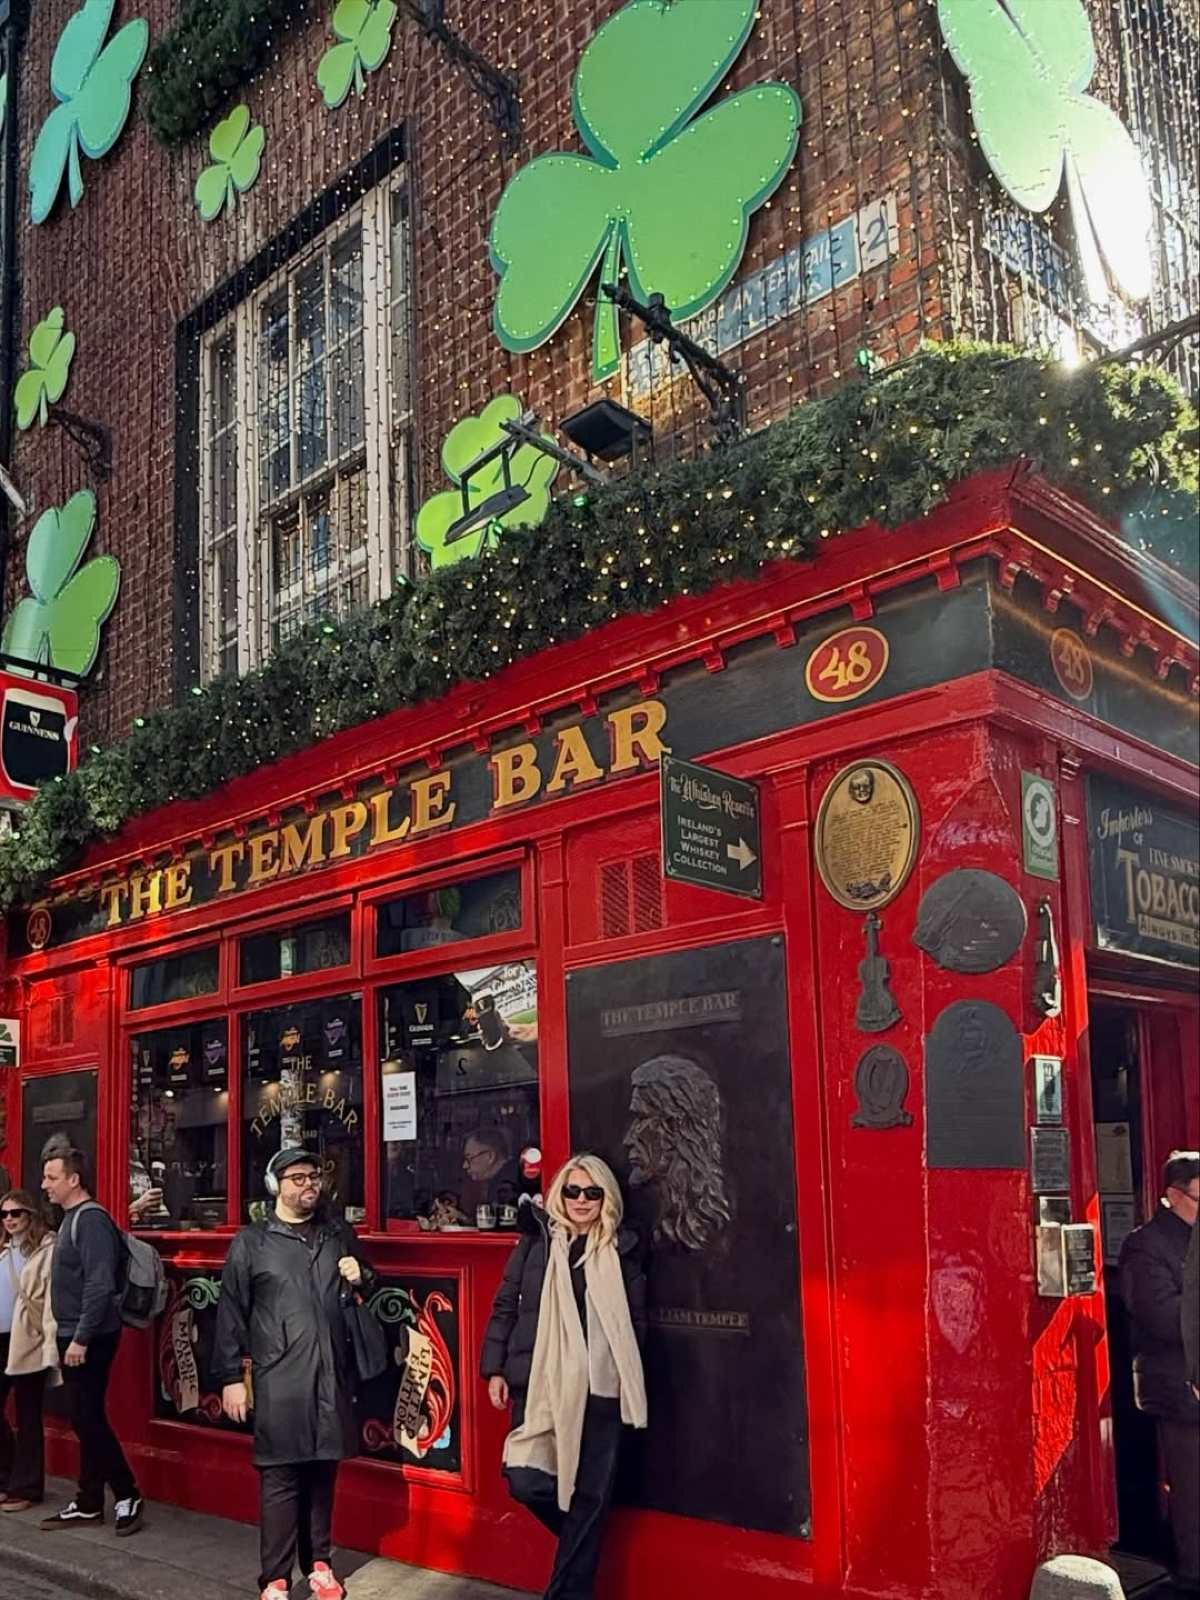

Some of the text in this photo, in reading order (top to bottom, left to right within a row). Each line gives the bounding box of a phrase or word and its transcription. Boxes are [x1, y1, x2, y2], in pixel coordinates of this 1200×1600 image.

[865, 217, 890, 252] 2
[818, 640, 872, 690] 48
[1058, 638, 1085, 683] 48
[9, 720, 60, 741] GUINNESS
[101, 700, 672, 927] THE TEMPLE BAR
[677, 815, 722, 837] IRELAND'S
[680, 828, 719, 848] LARGEST
[680, 841, 720, 861] WHISKEY
[673, 852, 728, 875] COLLECTION
[634, 999, 699, 1023] TEMPLE
[703, 991, 738, 1012] BAR
[290, 1055, 313, 1071] THE
[322, 1088, 359, 1133] BAR
